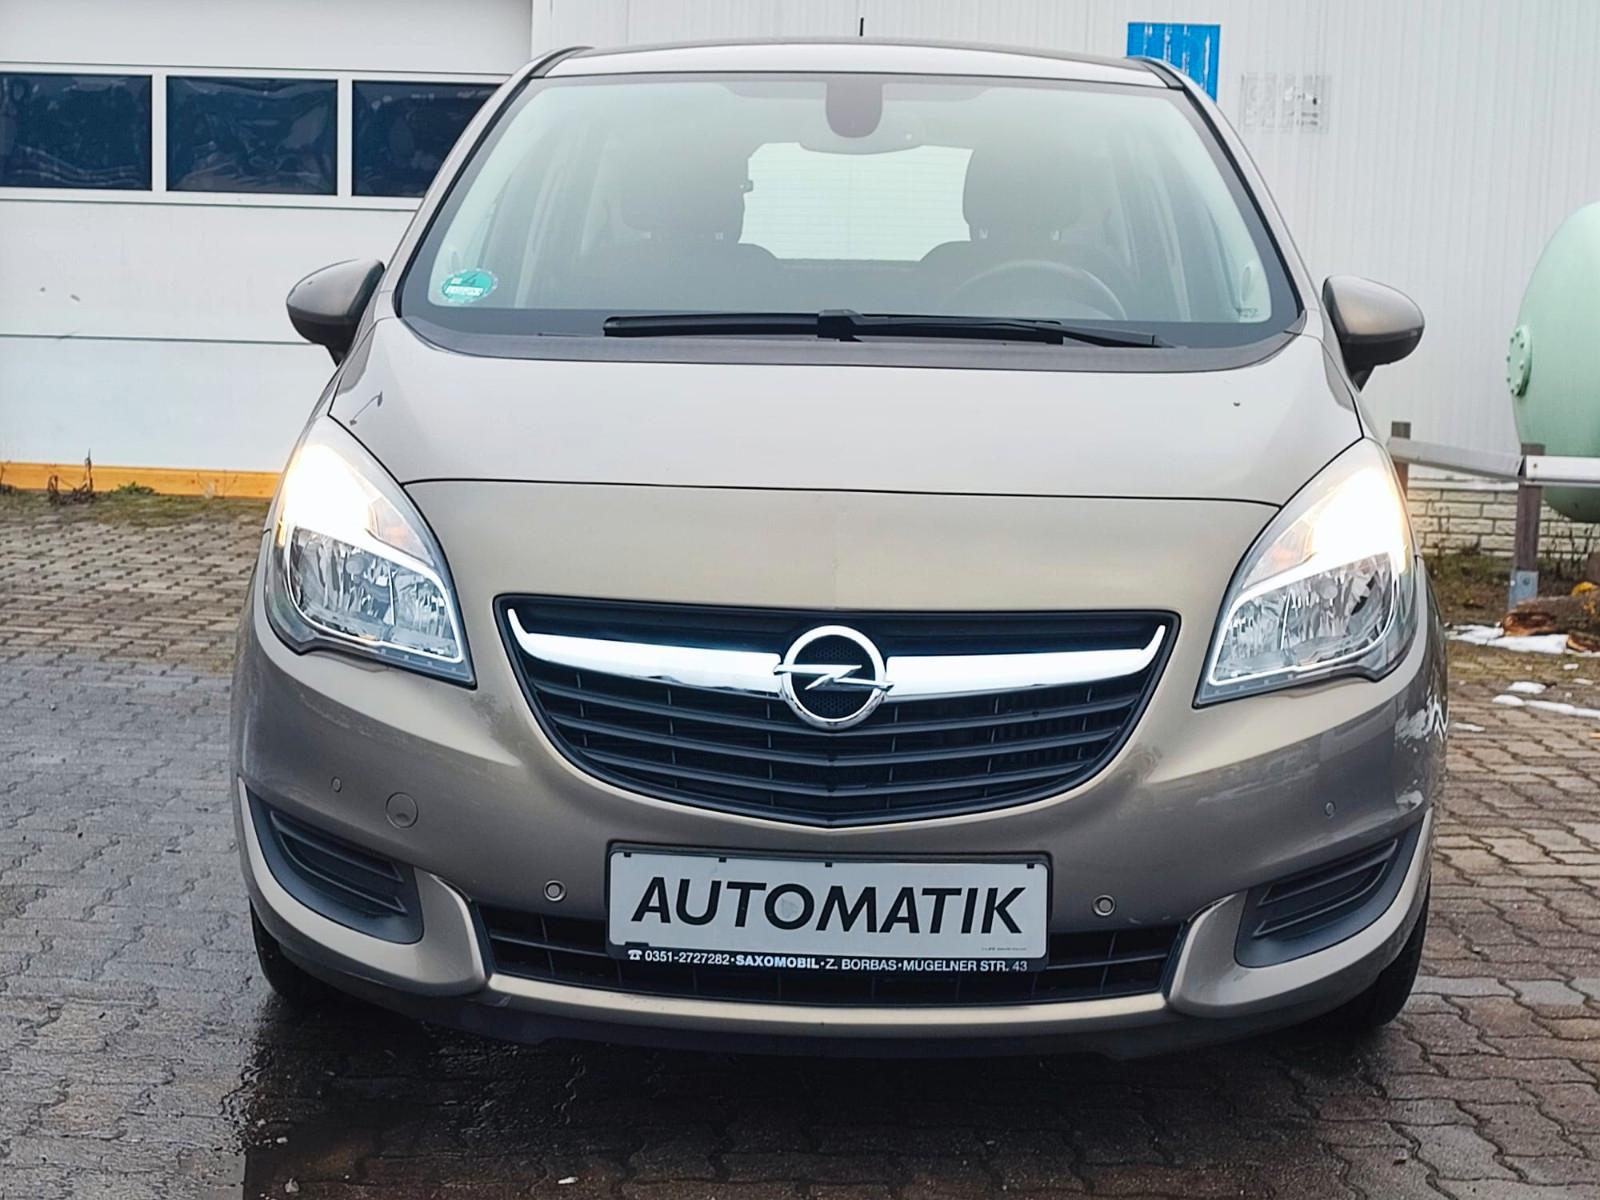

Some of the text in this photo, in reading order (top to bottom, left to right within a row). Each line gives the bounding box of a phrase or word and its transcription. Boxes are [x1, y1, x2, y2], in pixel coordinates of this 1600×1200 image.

[630, 876, 1026, 934] AUTOMATIK
[735, 954, 819, 969] SAXOMOBIL
[841, 959, 897, 971] BORBAS
[979, 960, 1009, 972] STR.
[1012, 960, 1028, 972] 43
